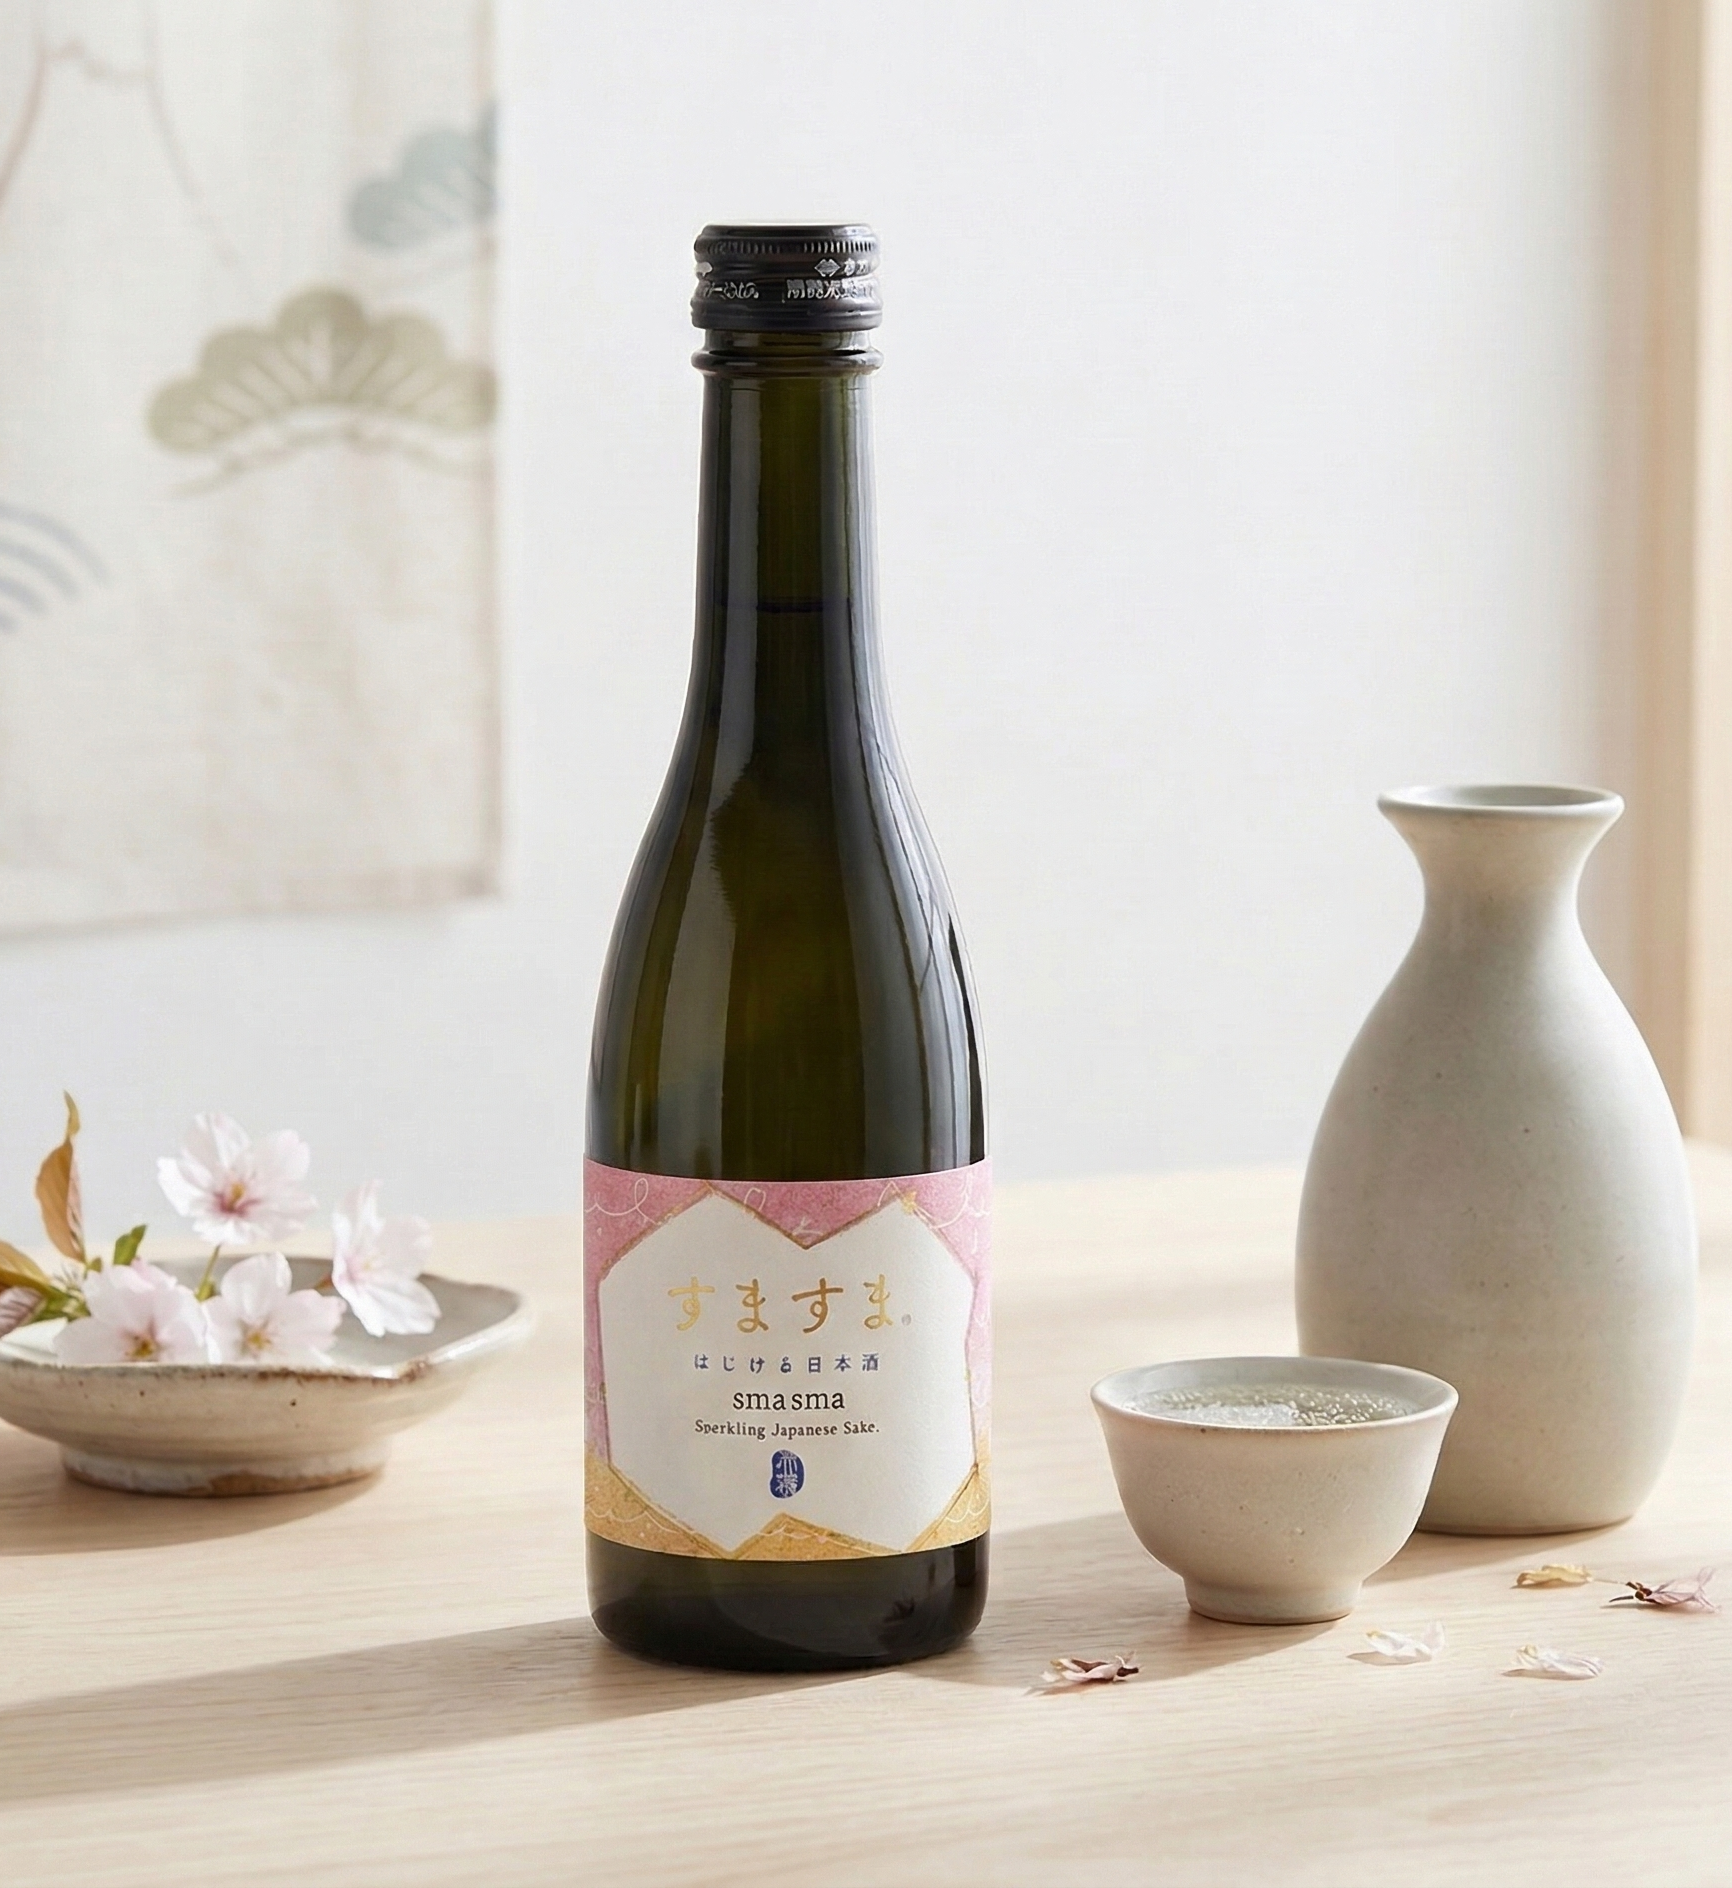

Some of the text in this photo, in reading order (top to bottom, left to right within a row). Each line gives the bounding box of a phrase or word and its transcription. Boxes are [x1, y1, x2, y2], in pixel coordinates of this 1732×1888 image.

[667, 1273, 894, 1334] すますま
[771, 1422, 838, 1440] Japanese
[843, 1420, 880, 1435] Sake.
